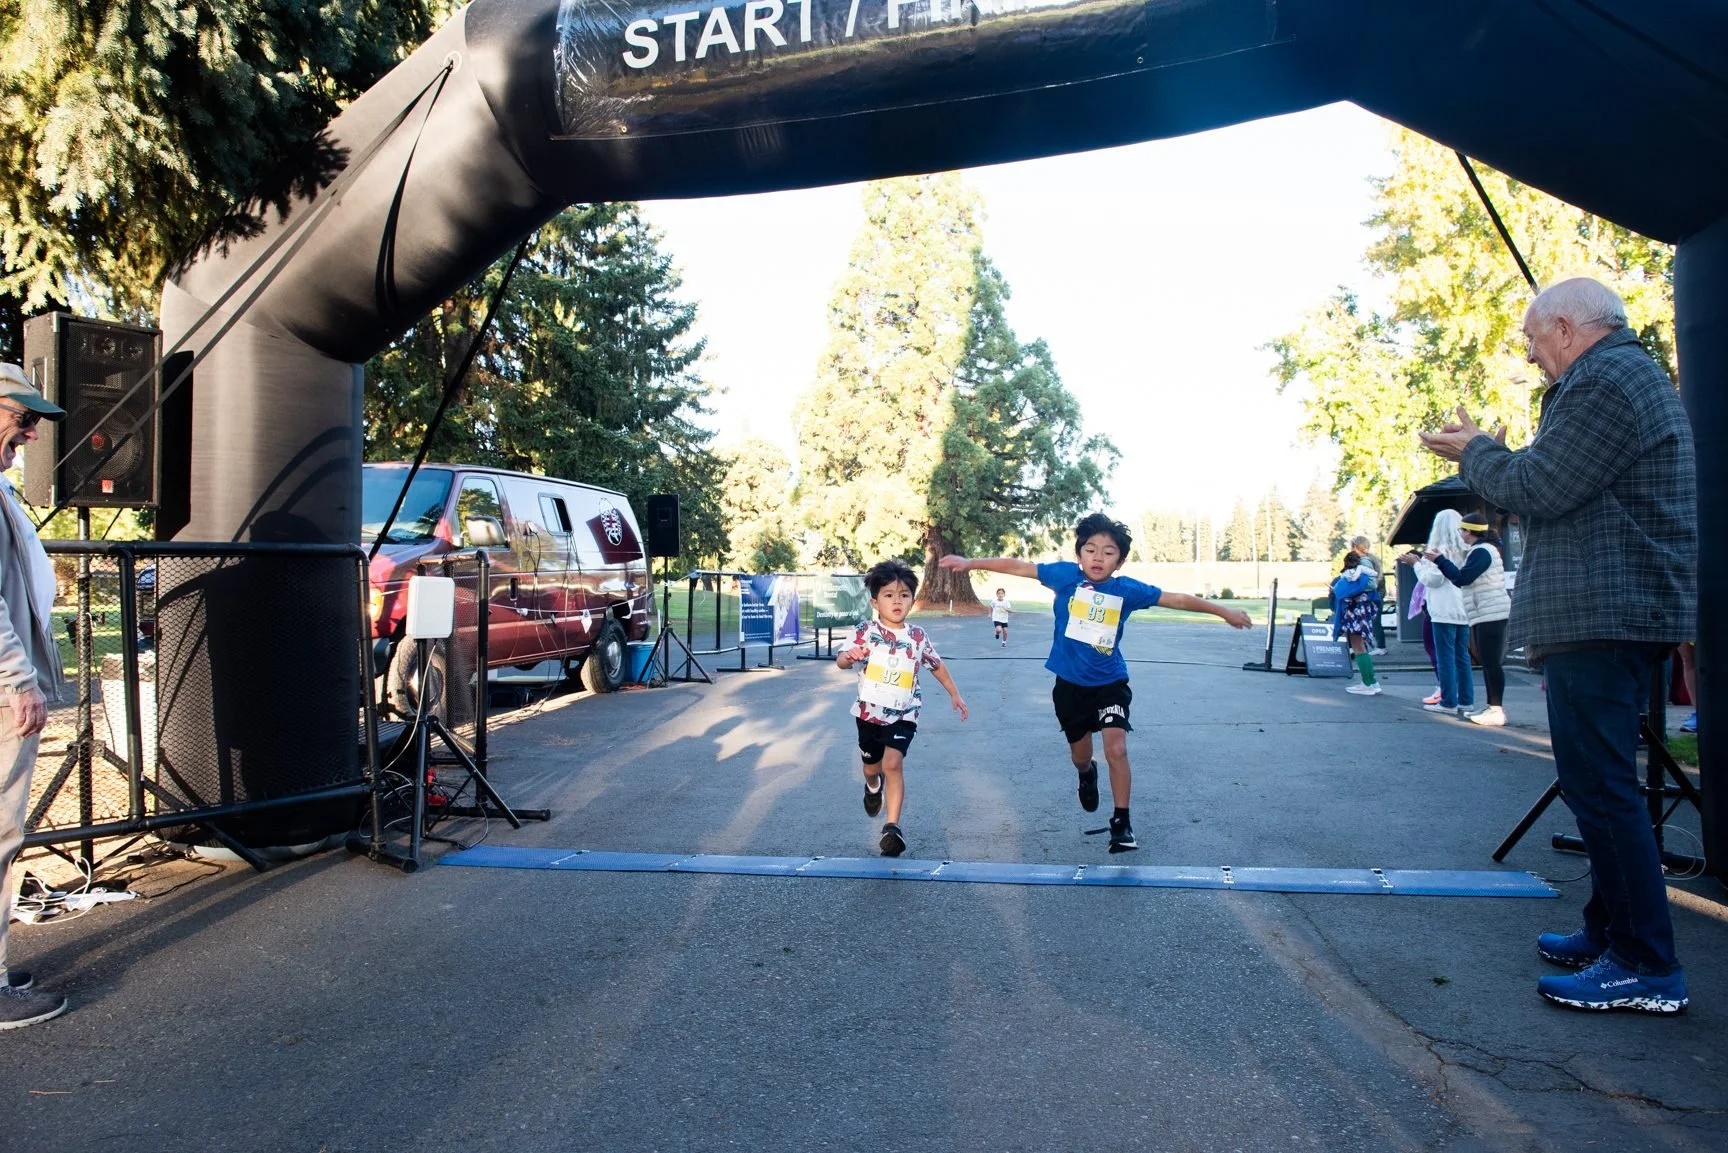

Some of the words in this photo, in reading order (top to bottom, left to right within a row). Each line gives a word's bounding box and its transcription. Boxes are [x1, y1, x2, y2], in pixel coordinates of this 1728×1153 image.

[622, 0, 812, 69] START
[1088, 605, 1105, 623] 93
[883, 669, 901, 686] 92
[1607, 977, 1638, 987] Columbia
